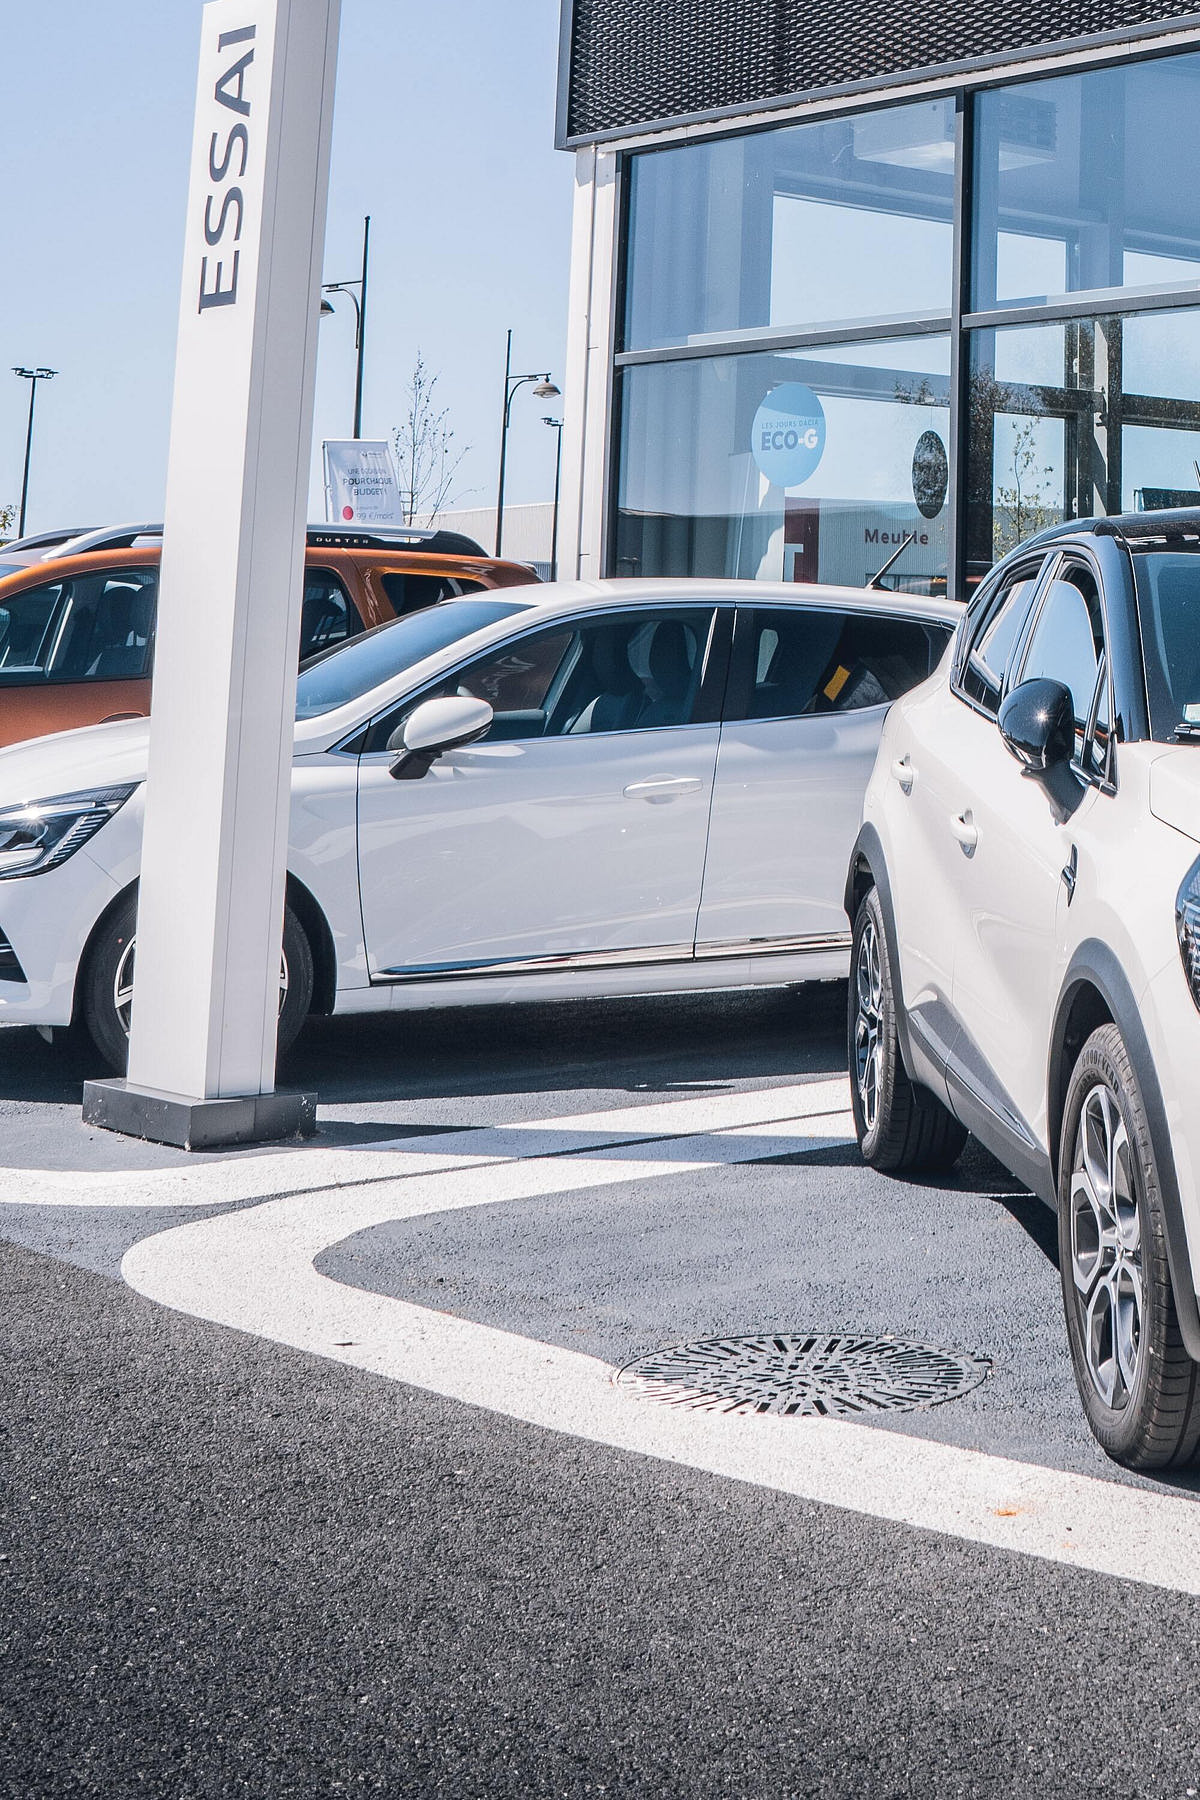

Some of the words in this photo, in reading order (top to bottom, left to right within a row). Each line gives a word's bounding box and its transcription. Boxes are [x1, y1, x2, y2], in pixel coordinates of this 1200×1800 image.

[198, 24, 256, 315] ESSAI
[761, 428, 819, 451] ECO-G
[343, 478, 366, 486] POUR
[366, 477, 393, 485] CHAQUE
[354, 488, 383, 496] BUDGET
[864, 528, 929, 545] Meuble
